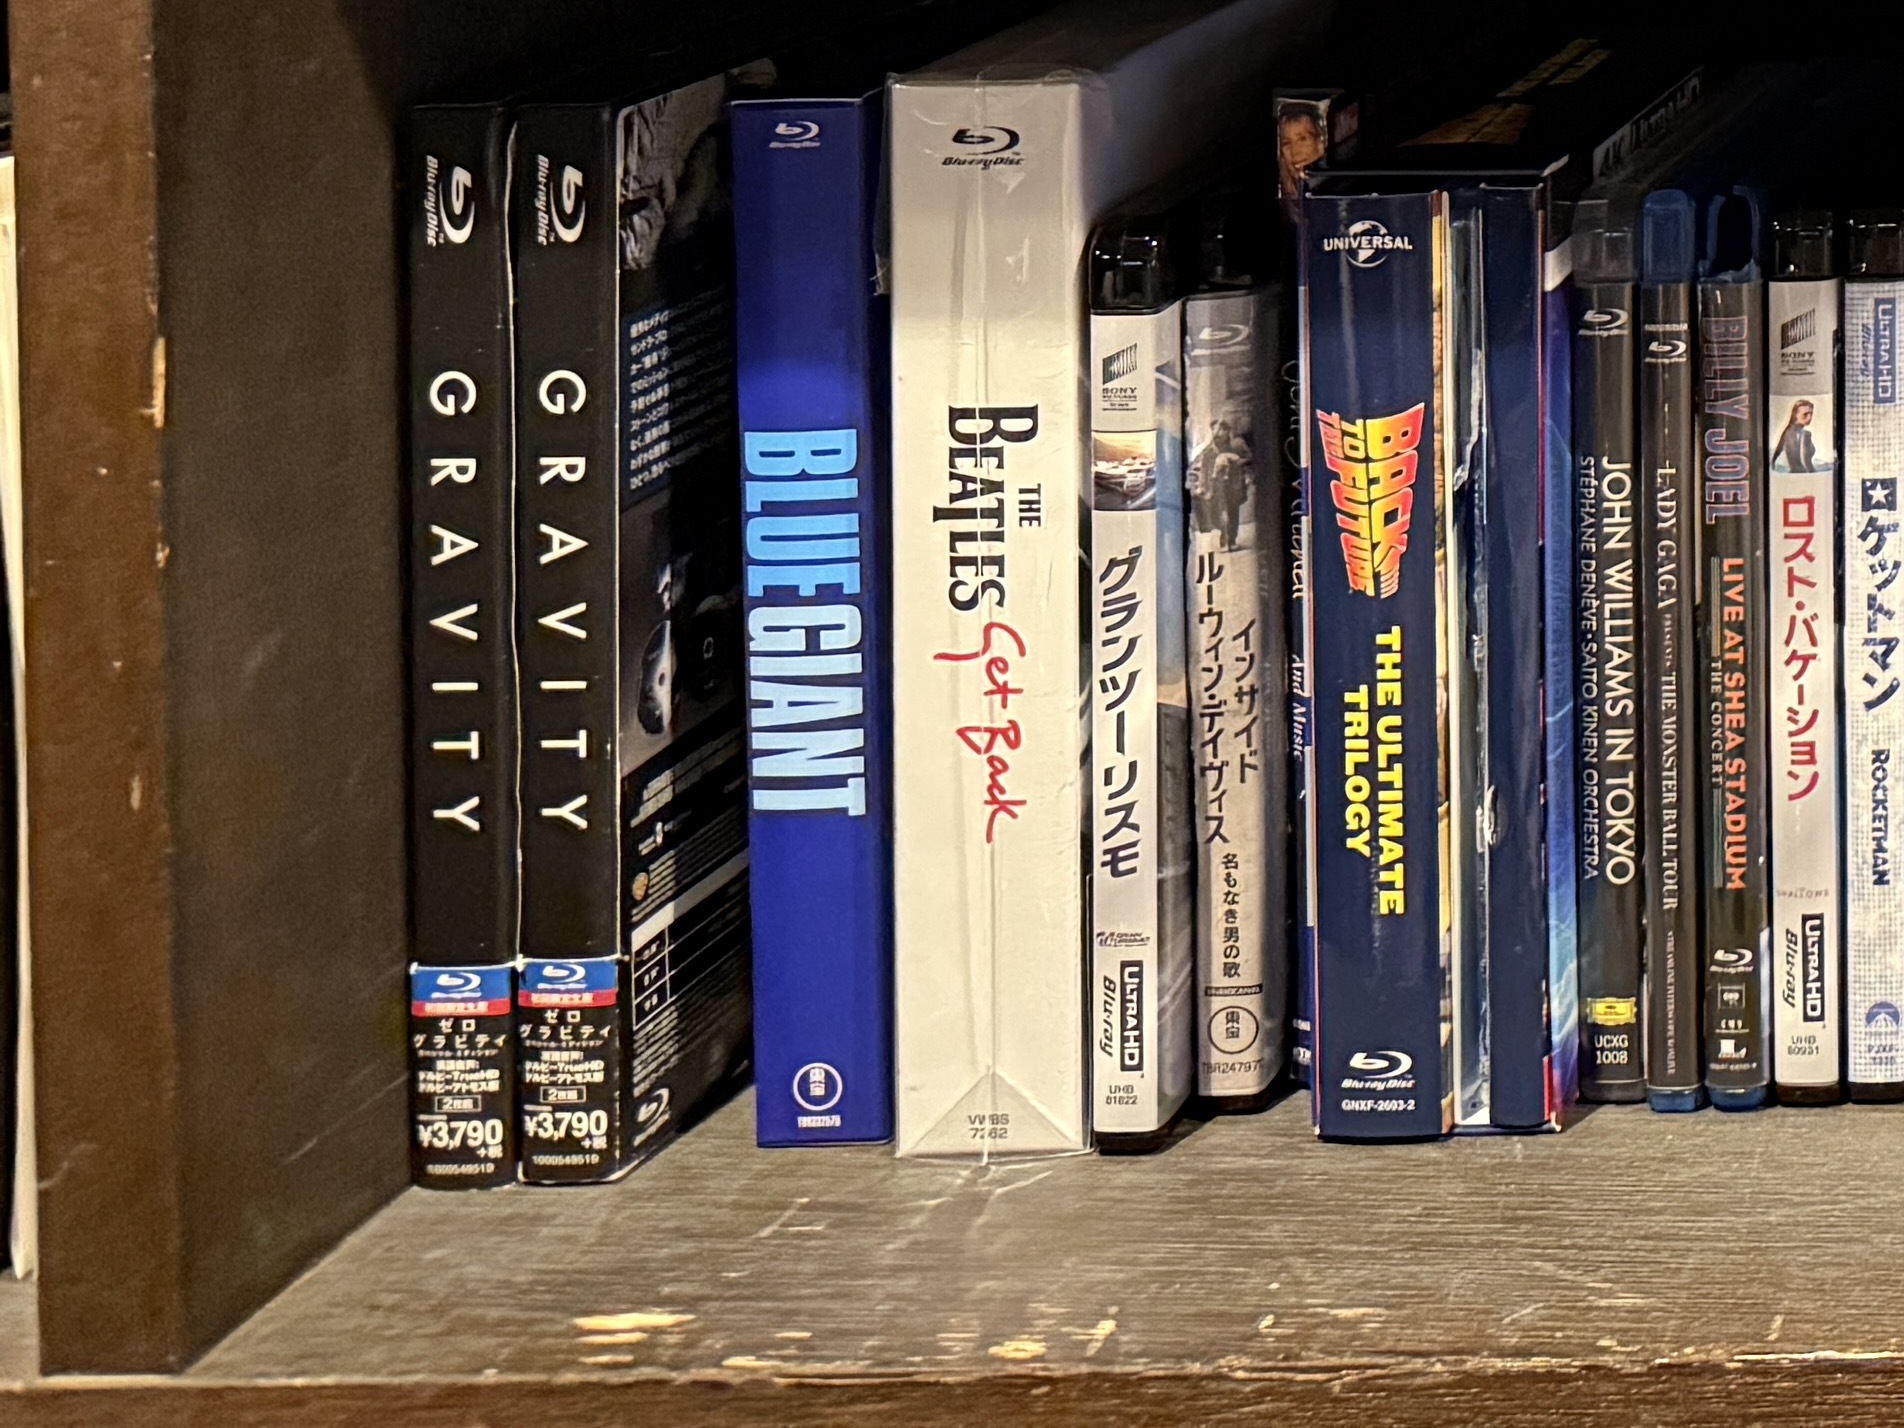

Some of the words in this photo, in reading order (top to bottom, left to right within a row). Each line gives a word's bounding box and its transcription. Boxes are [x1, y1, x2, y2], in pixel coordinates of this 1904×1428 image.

[1701, 315, 1750, 421] BILLY
[743, 428, 862, 600] BLUE
[932, 403, 1041, 612] BEATLES
[1017, 482, 1043, 528] THE
[1601, 456, 1633, 550] JOHN
[1656, 467, 1678, 532] LADY
[1703, 426, 1752, 527] JOEL
[428, 369, 480, 834] GRAVITY
[538, 367, 590, 831] GRAVITY
[1376, 625, 1404, 704] THE
[1604, 557, 1635, 718] WILLIAMS
[1782, 495, 1823, 802] ロスト・バケーション
[748, 603, 867, 817] GIANT
[1096, 545, 1144, 880] グランツーリスモ
[1229, 618, 1261, 784] インサイド
[1343, 684, 1374, 859] TRILOGY
[1605, 727, 1636, 762] IN
[1377, 710, 1406, 917] ULTIMATE
[1605, 770, 1637, 886] TOKYO
[1871, 748, 1891, 887] ROCKETMAN
[1220, 851, 1243, 980] 名もなき男の歌
